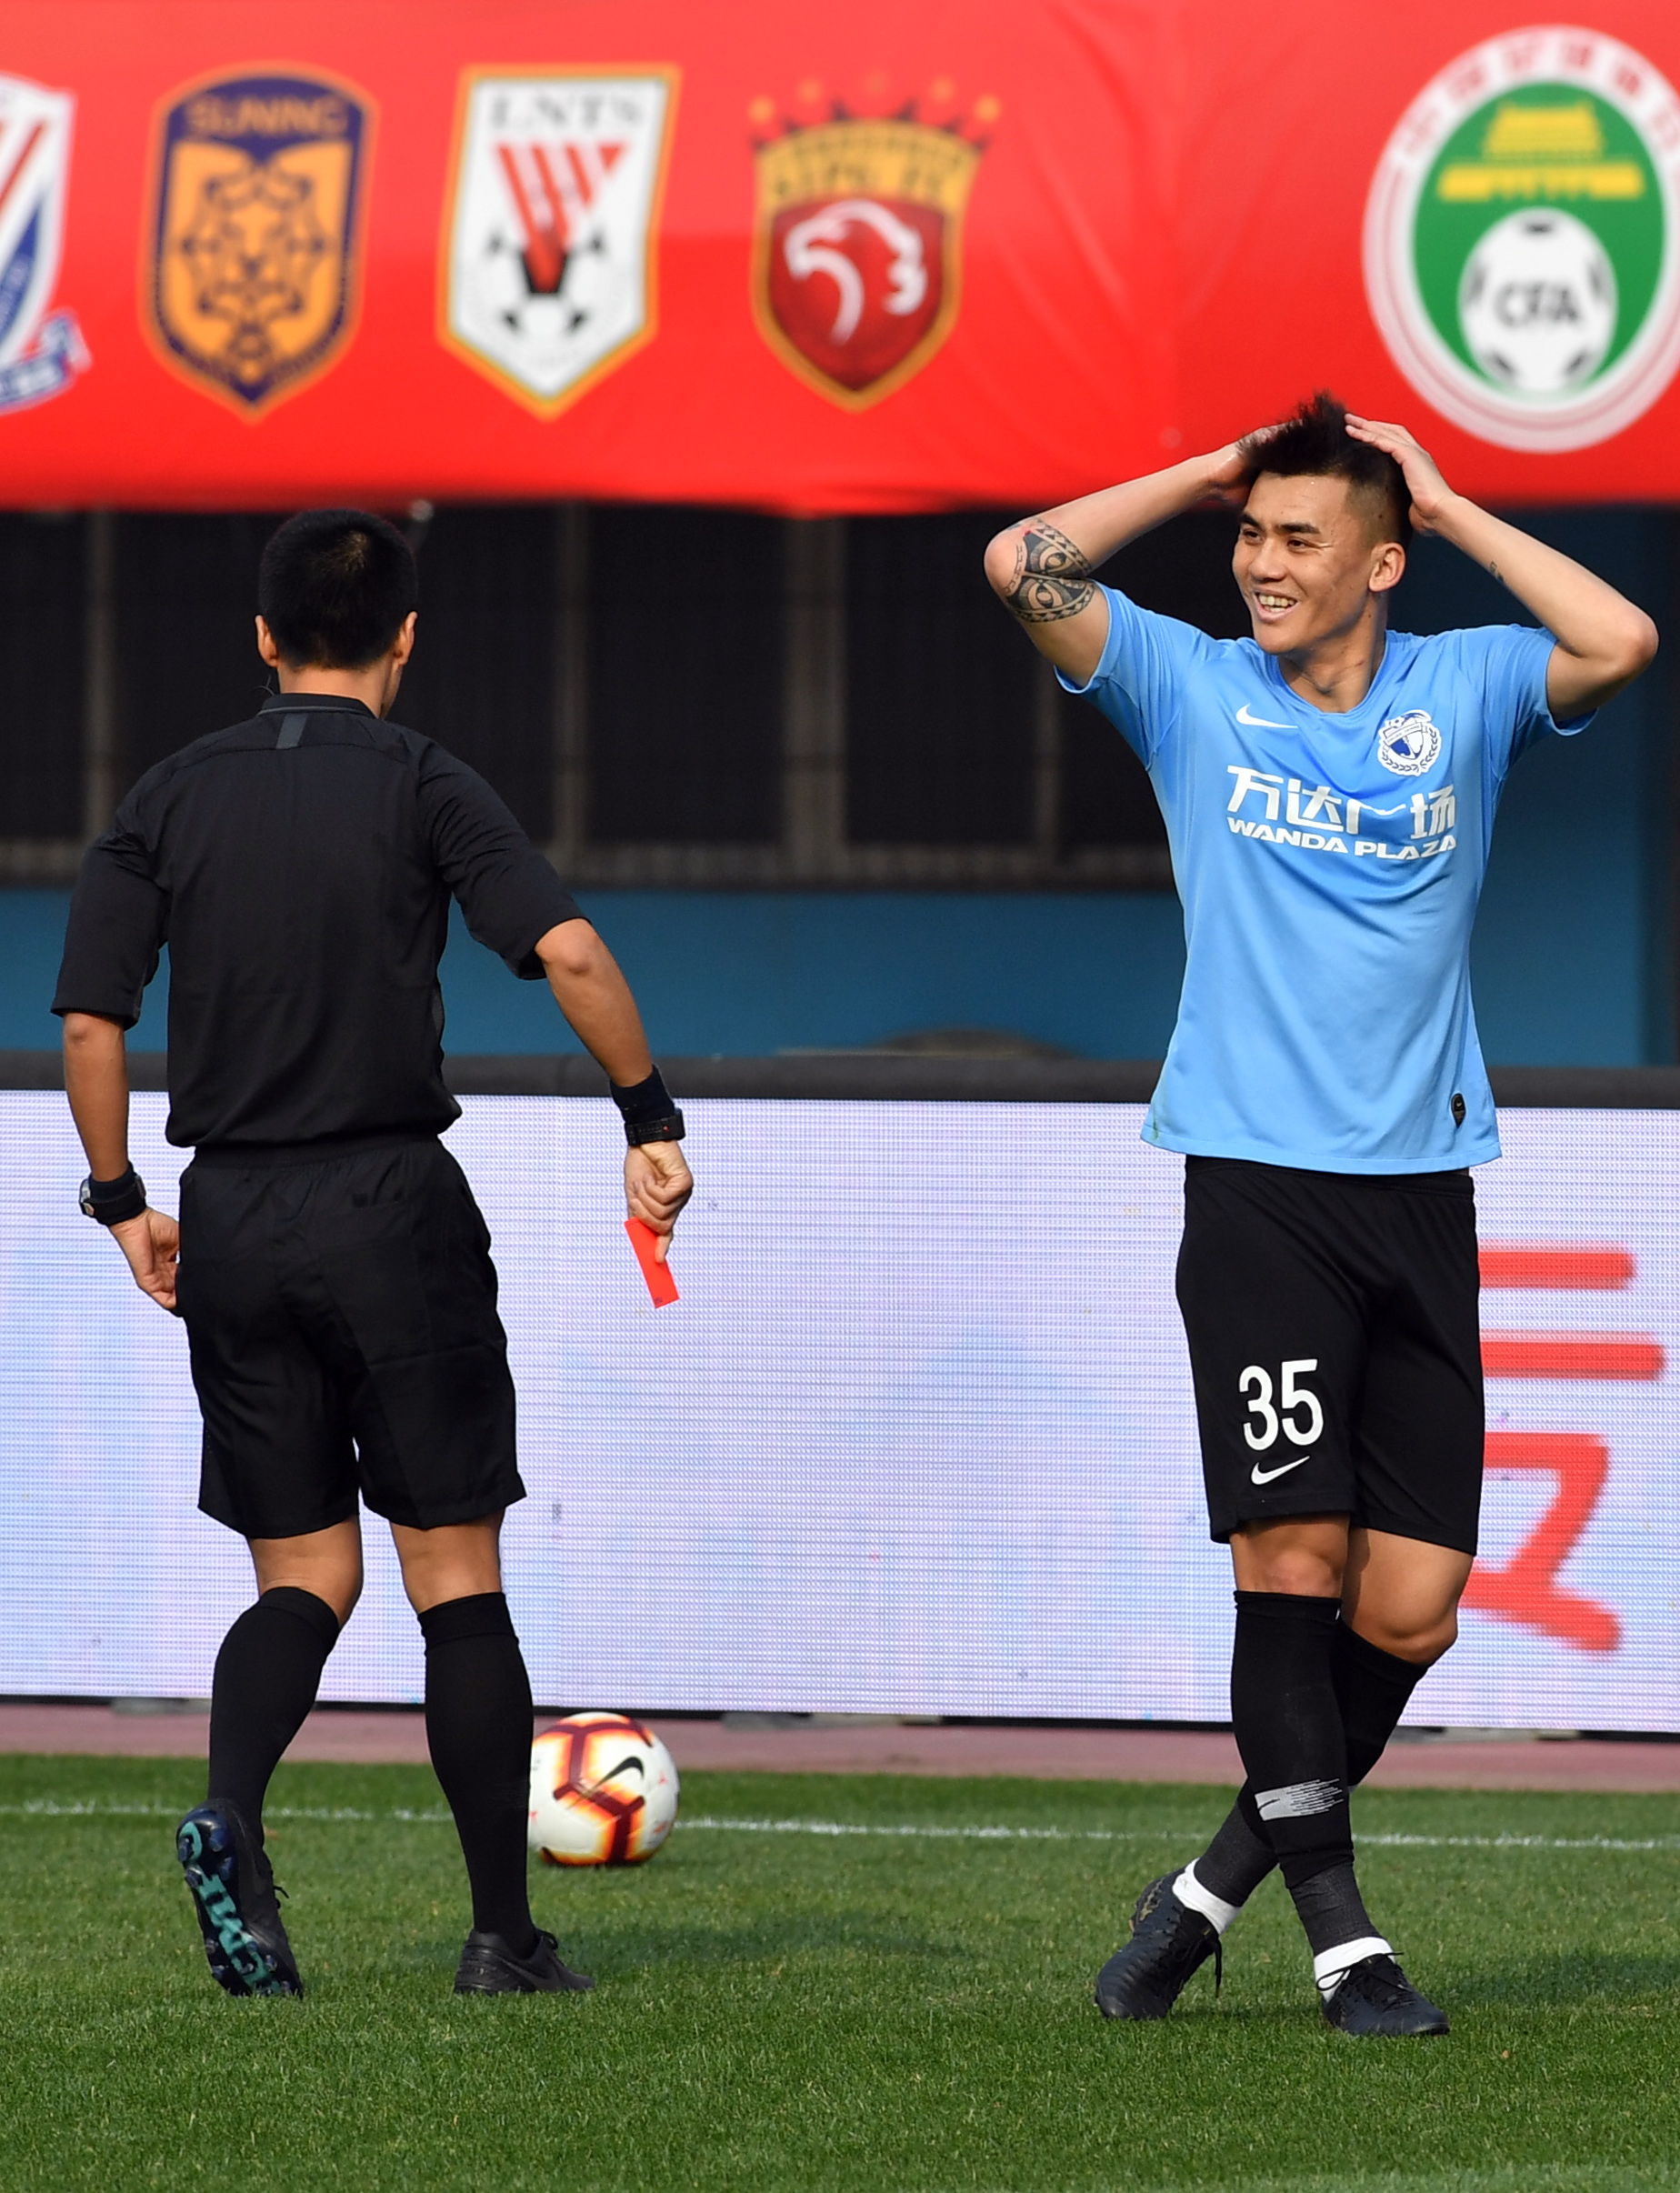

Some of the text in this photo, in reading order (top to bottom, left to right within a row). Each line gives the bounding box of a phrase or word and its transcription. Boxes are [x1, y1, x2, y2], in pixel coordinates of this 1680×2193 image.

[1493, 281, 1584, 329] CFA
[1227, 816, 1456, 860] WANDA PLAZA
[1239, 1358, 1324, 1451] 35
